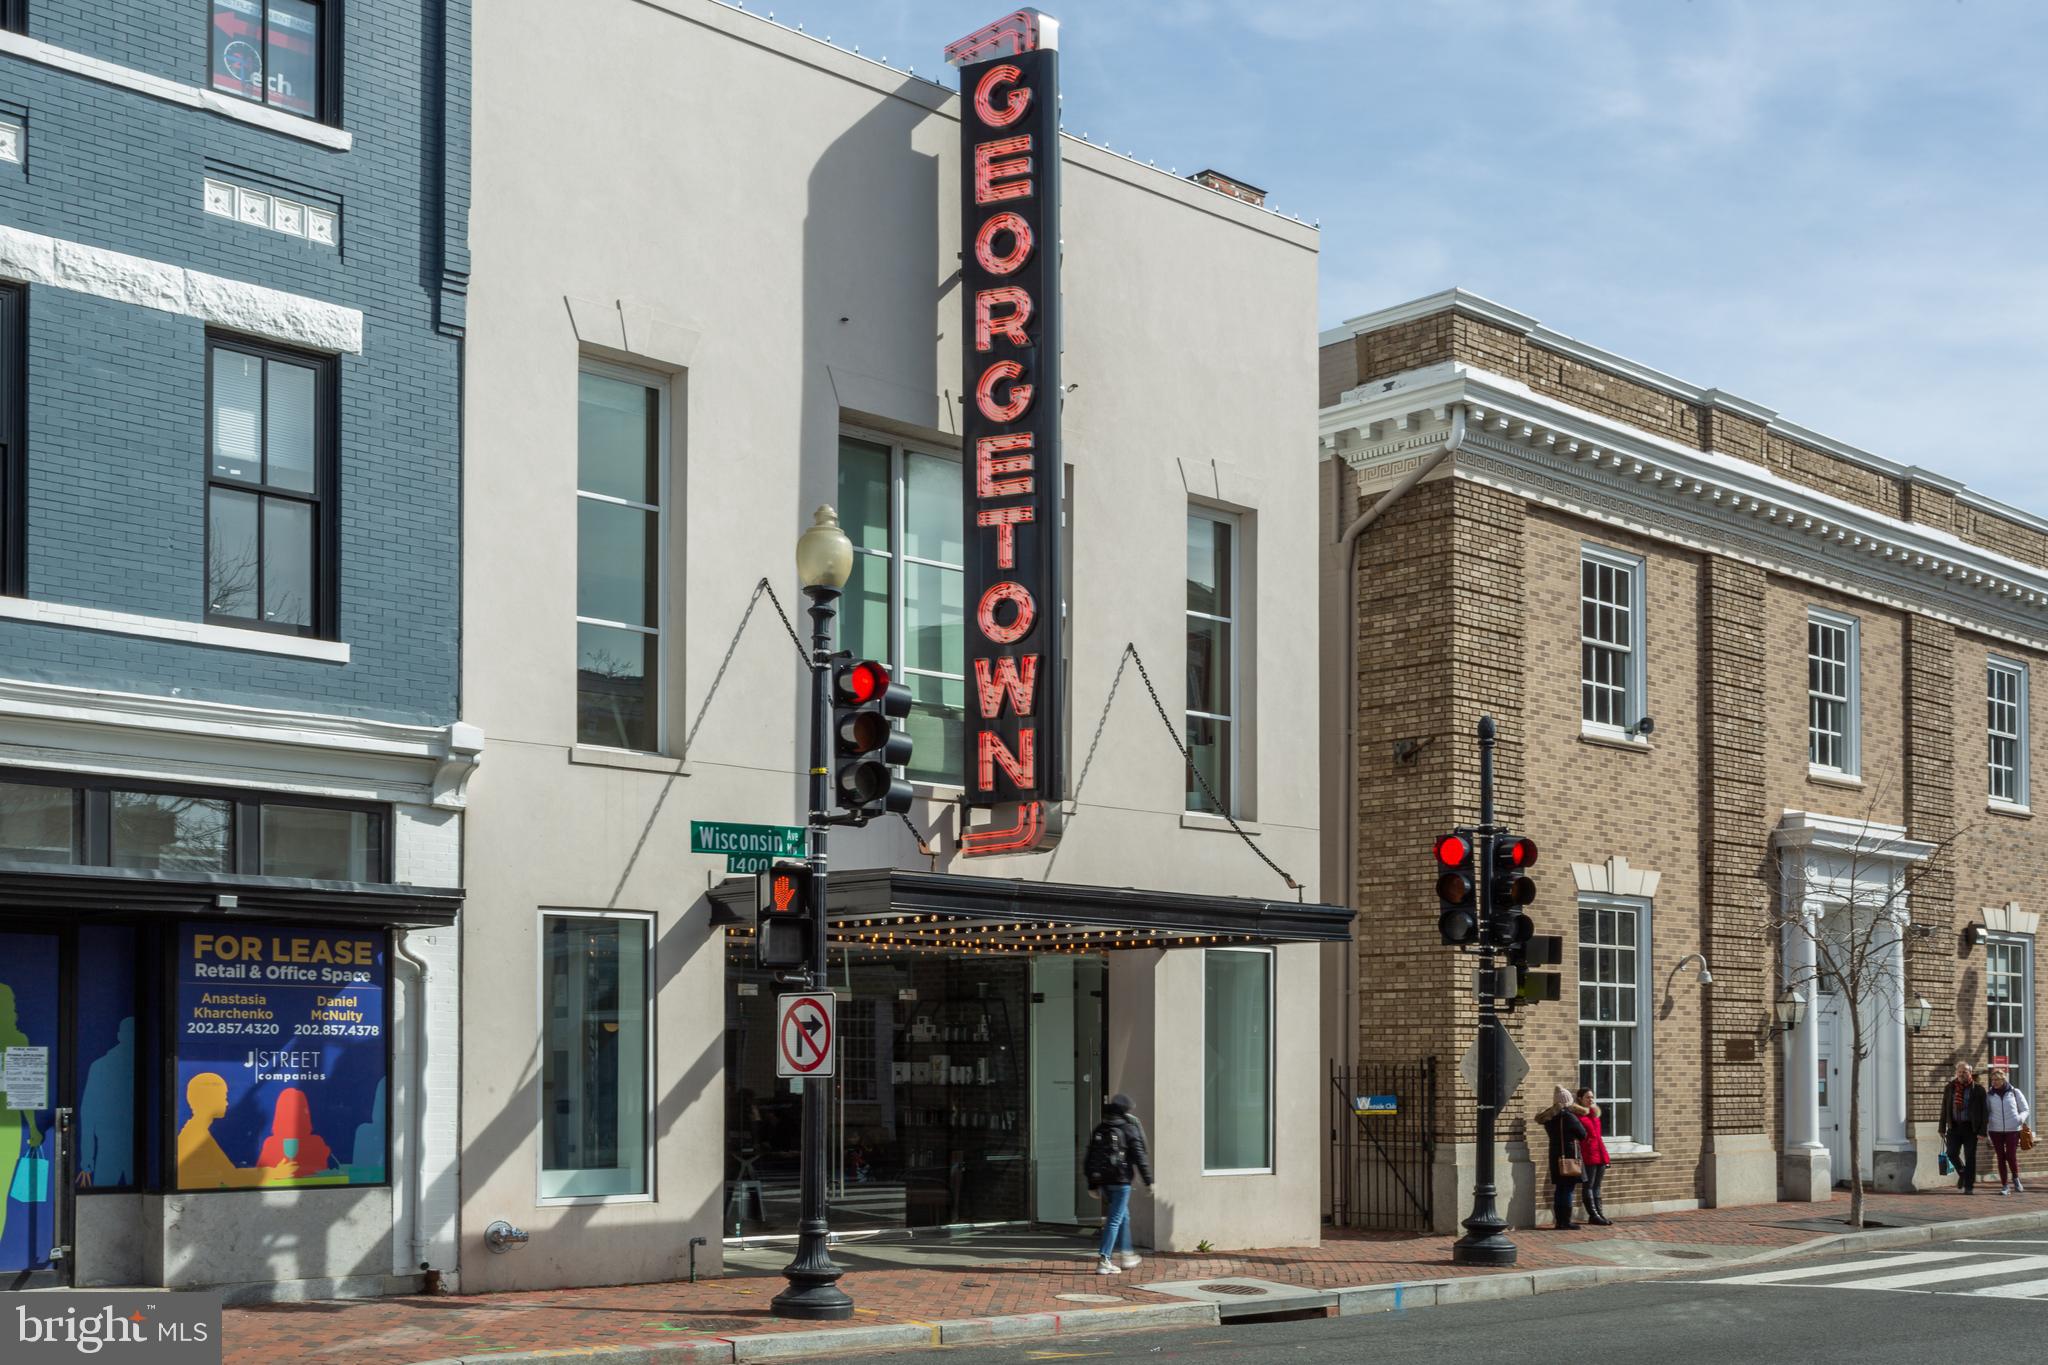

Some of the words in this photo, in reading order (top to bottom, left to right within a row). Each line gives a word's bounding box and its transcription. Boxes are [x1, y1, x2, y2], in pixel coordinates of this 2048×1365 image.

[974, 64, 1039, 792] GEORGETOWN
[699, 826, 783, 852] Wisconsin
[786, 829, 799, 841] Ave
[729, 857, 769, 873] 1400
[194, 934, 262, 961] FOR
[272, 938, 373, 965] LEASE
[195, 963, 246, 978] Retail
[249, 965, 262, 979] &
[266, 965, 317, 981] Office
[321, 968, 371, 984] Space
[202, 993, 267, 1005] Anastasia
[317, 995, 357, 1007] Daniel
[194, 1007, 273, 1020] Kharchenko
[311, 1010, 363, 1023] McNulty
[187, 1022, 280, 1035] 202.857.4320
[294, 1024, 380, 1036] 202.857.4378
[258, 1071, 326, 1083] companies
